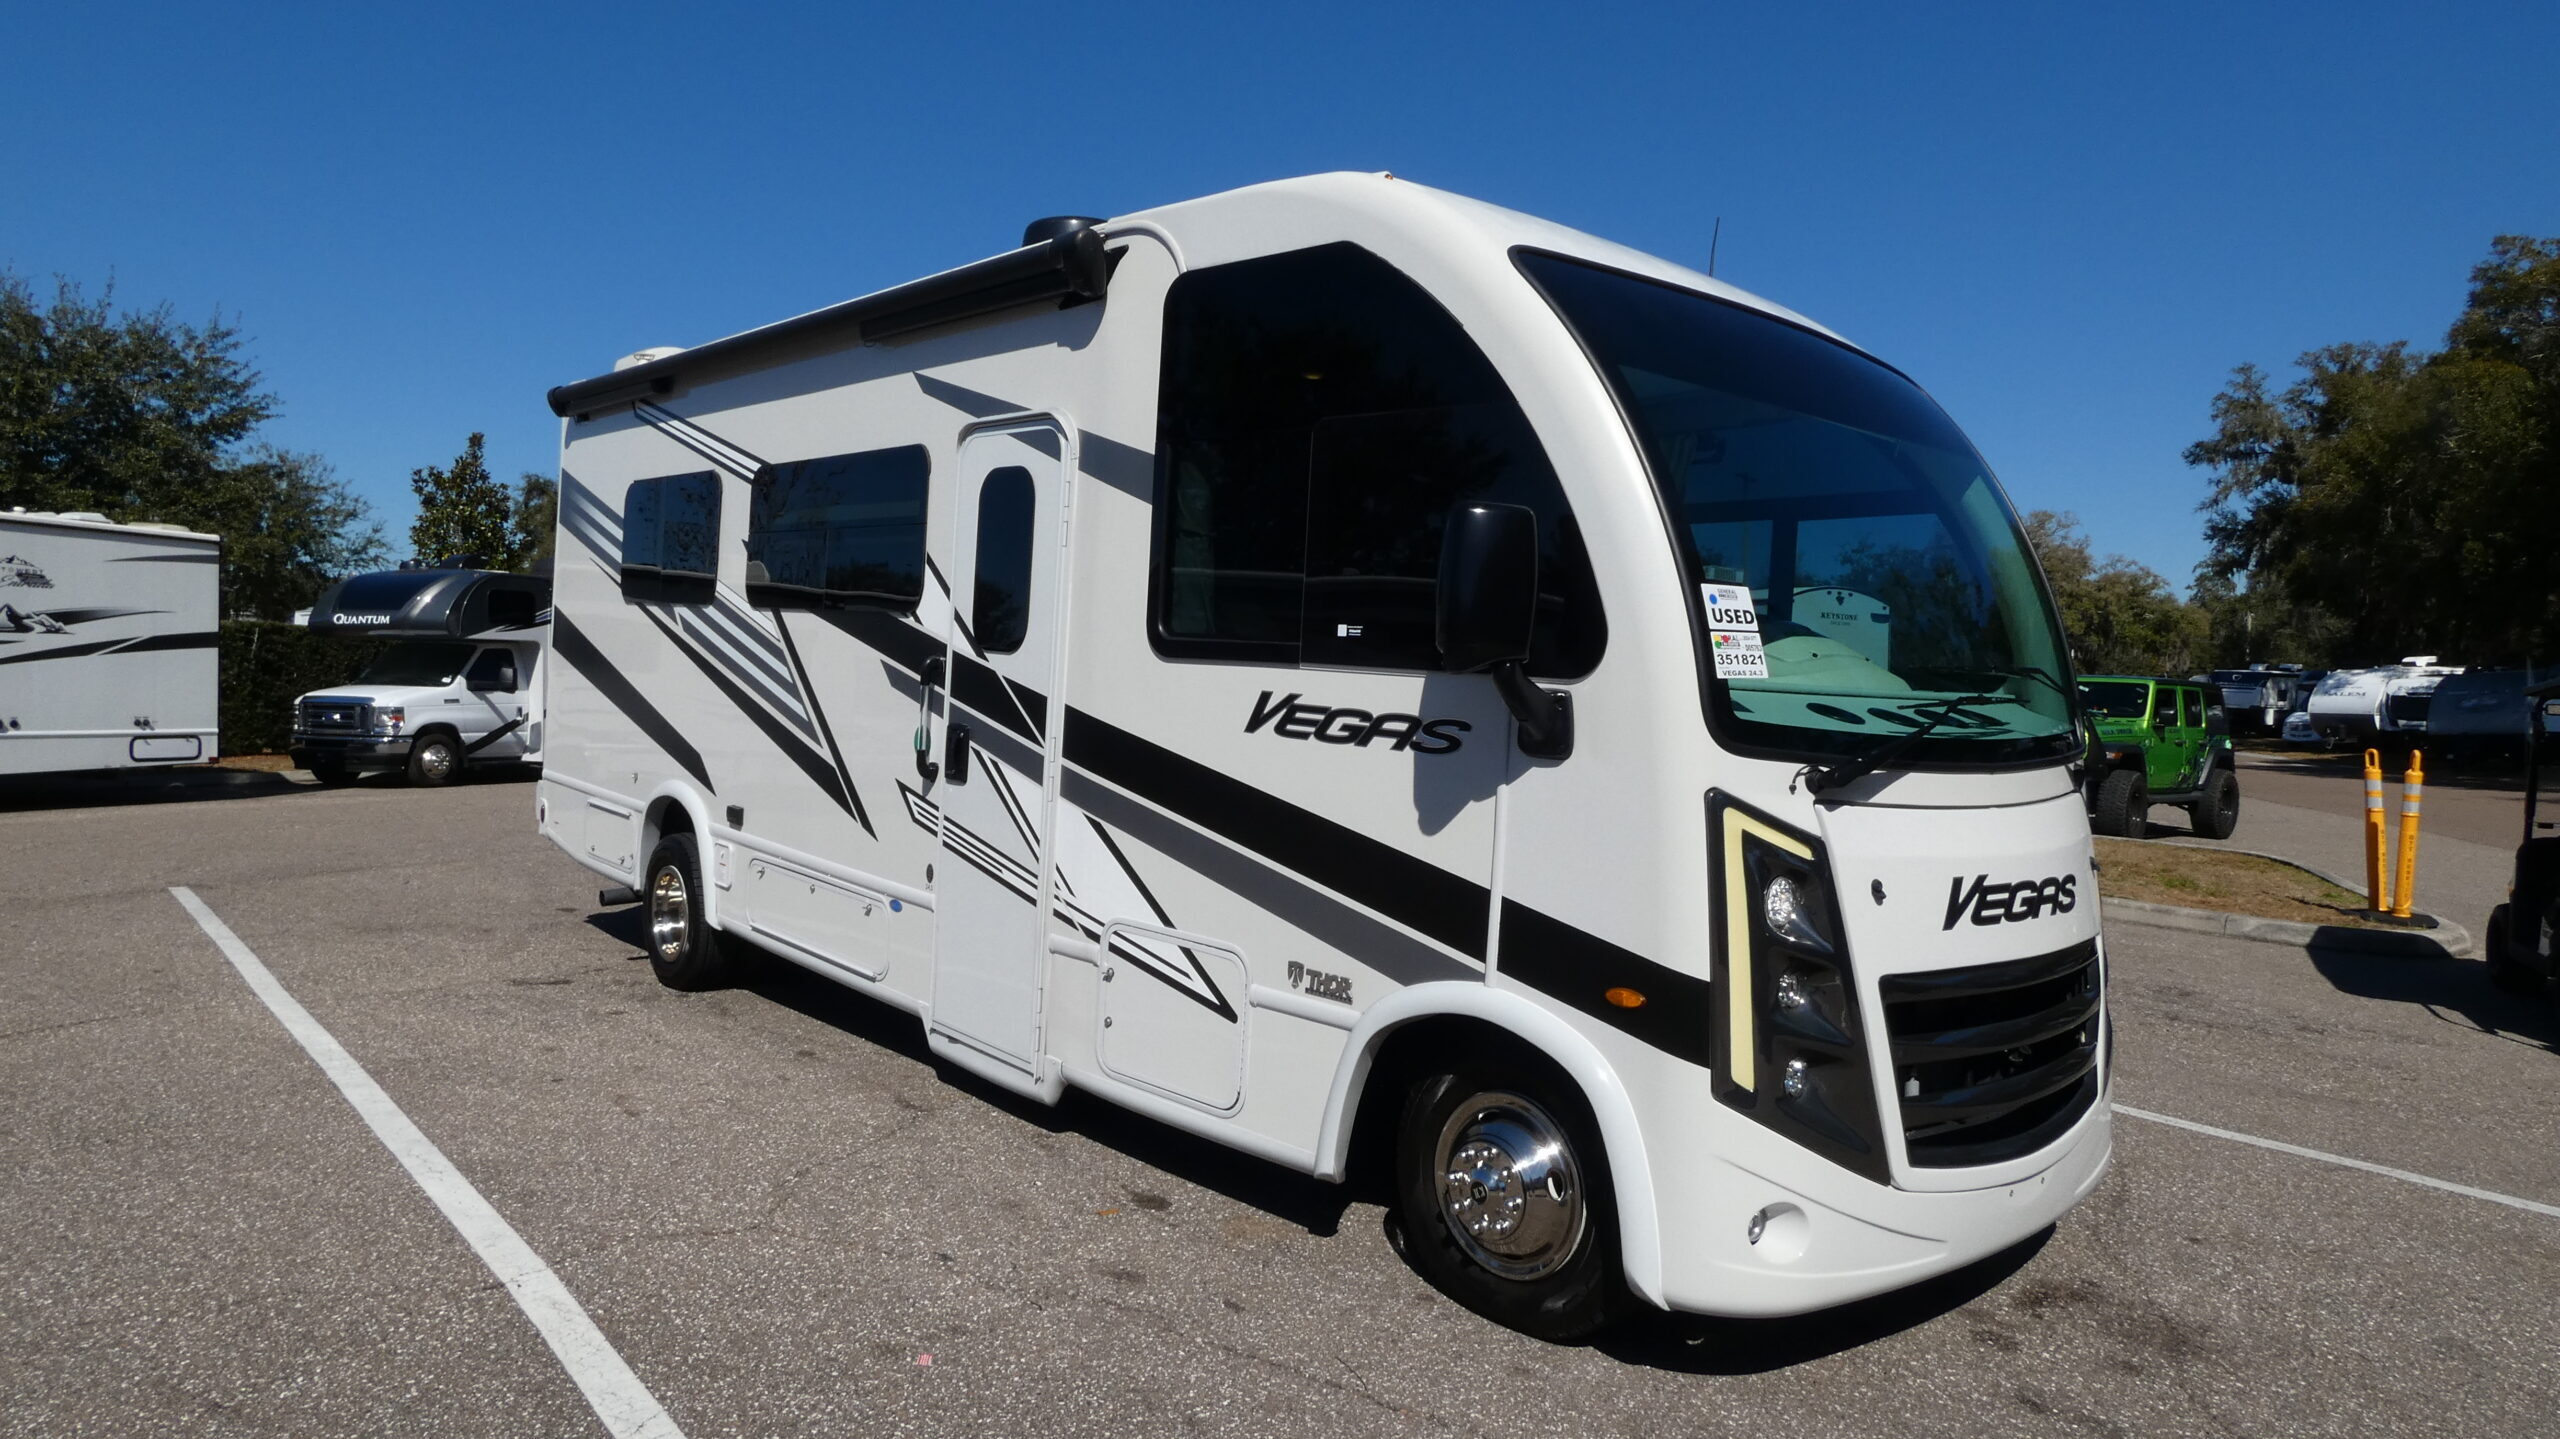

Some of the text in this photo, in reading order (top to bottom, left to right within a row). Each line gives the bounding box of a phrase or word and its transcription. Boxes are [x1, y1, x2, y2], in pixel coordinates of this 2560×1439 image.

[333, 613, 390, 625] QUANTUM
[1711, 607, 1755, 624] USED
[1820, 612, 1859, 621] KEYSTONE
[1717, 654, 1764, 665] 351821
[1243, 690, 1472, 755] VEGAS
[1942, 874, 2077, 931] VEGAS
[1305, 968, 1353, 1001] THOR
